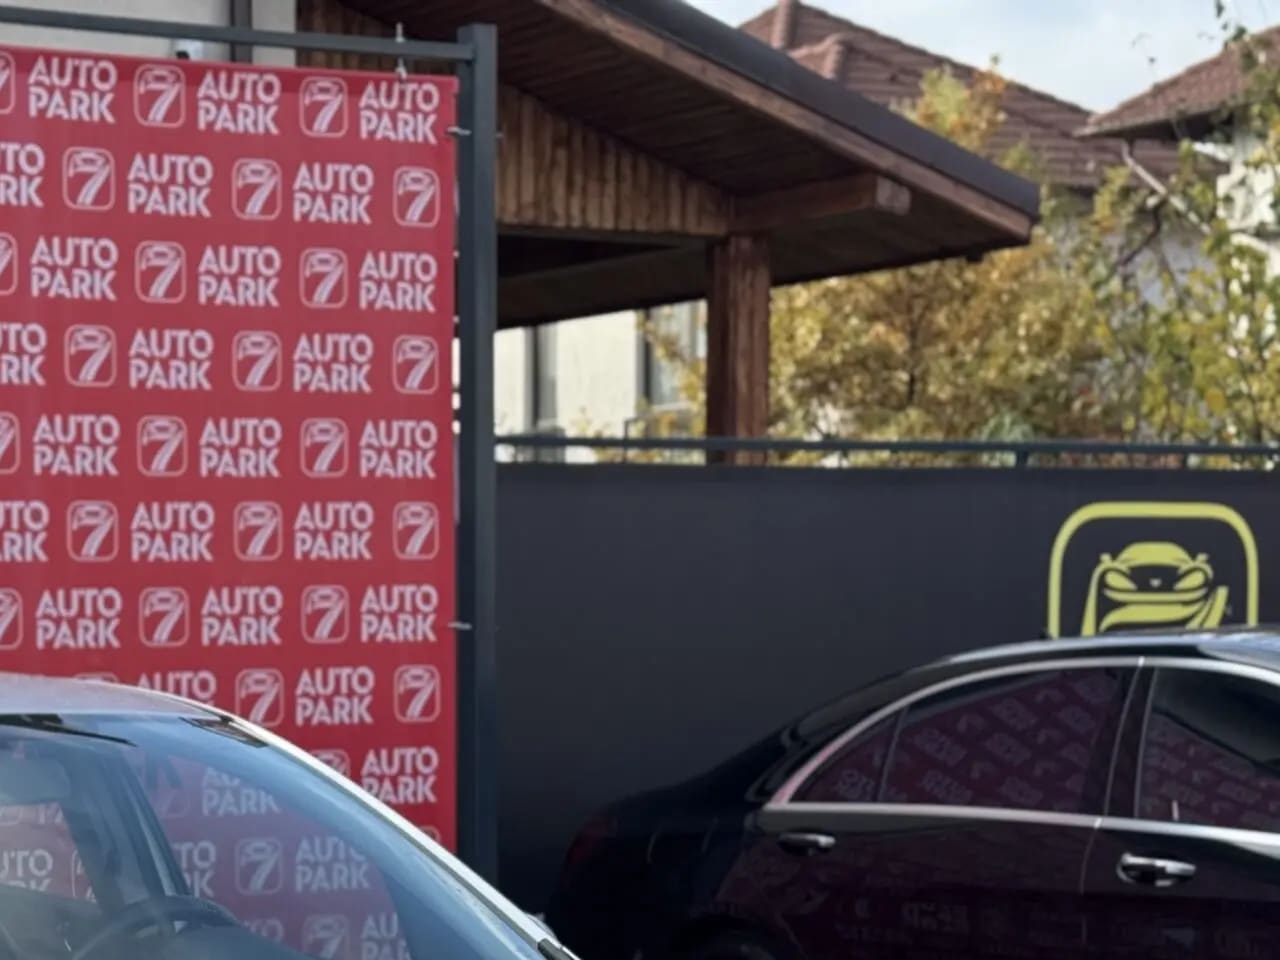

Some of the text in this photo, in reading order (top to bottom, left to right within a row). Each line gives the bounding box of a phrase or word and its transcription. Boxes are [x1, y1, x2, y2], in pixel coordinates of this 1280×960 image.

[28, 58, 116, 91] AUTO
[197, 72, 280, 105] AUTO
[28, 86, 115, 124] PARK
[359, 82, 439, 112] AUTO
[197, 99, 278, 134] PARK
[360, 108, 436, 144] PARK
[128, 153, 213, 187] AUTO
[293, 163, 374, 193] AUTO
[128, 182, 210, 217] PARK
[293, 192, 371, 224] PARK
[31, 236, 118, 269] AUTO
[198, 246, 281, 276] AUTO
[359, 251, 437, 282] AUTO
[31, 265, 116, 300] PARK
[198, 274, 278, 306] PARK
[359, 280, 435, 312] PARK
[129, 328, 213, 359] AUTO
[293, 333, 373, 364] AUTO
[129, 358, 211, 390] PARK
[293, 362, 371, 393] PARK
[33, 414, 120, 445] AUTO
[200, 418, 282, 447] AUTO
[360, 420, 437, 449] AUTO
[33, 444, 117, 475] PARK
[200, 446, 279, 477] PARK
[359, 448, 435, 478] PARK
[131, 501, 215, 532] AUTO
[294, 501, 373, 532] AUTO
[131, 531, 212, 561] PARK
[294, 530, 371, 560] PARK
[36, 588, 122, 619] AUTO
[201, 586, 283, 617] AUTO
[360, 584, 438, 614] AUTO
[36, 617, 119, 649] PARK
[202, 615, 280, 646] PARK
[361, 612, 436, 642] PARK
[295, 666, 375, 697] AUTO
[295, 694, 373, 726] PARK
[361, 747, 439, 776] AUTO
[362, 775, 437, 805] PARK
